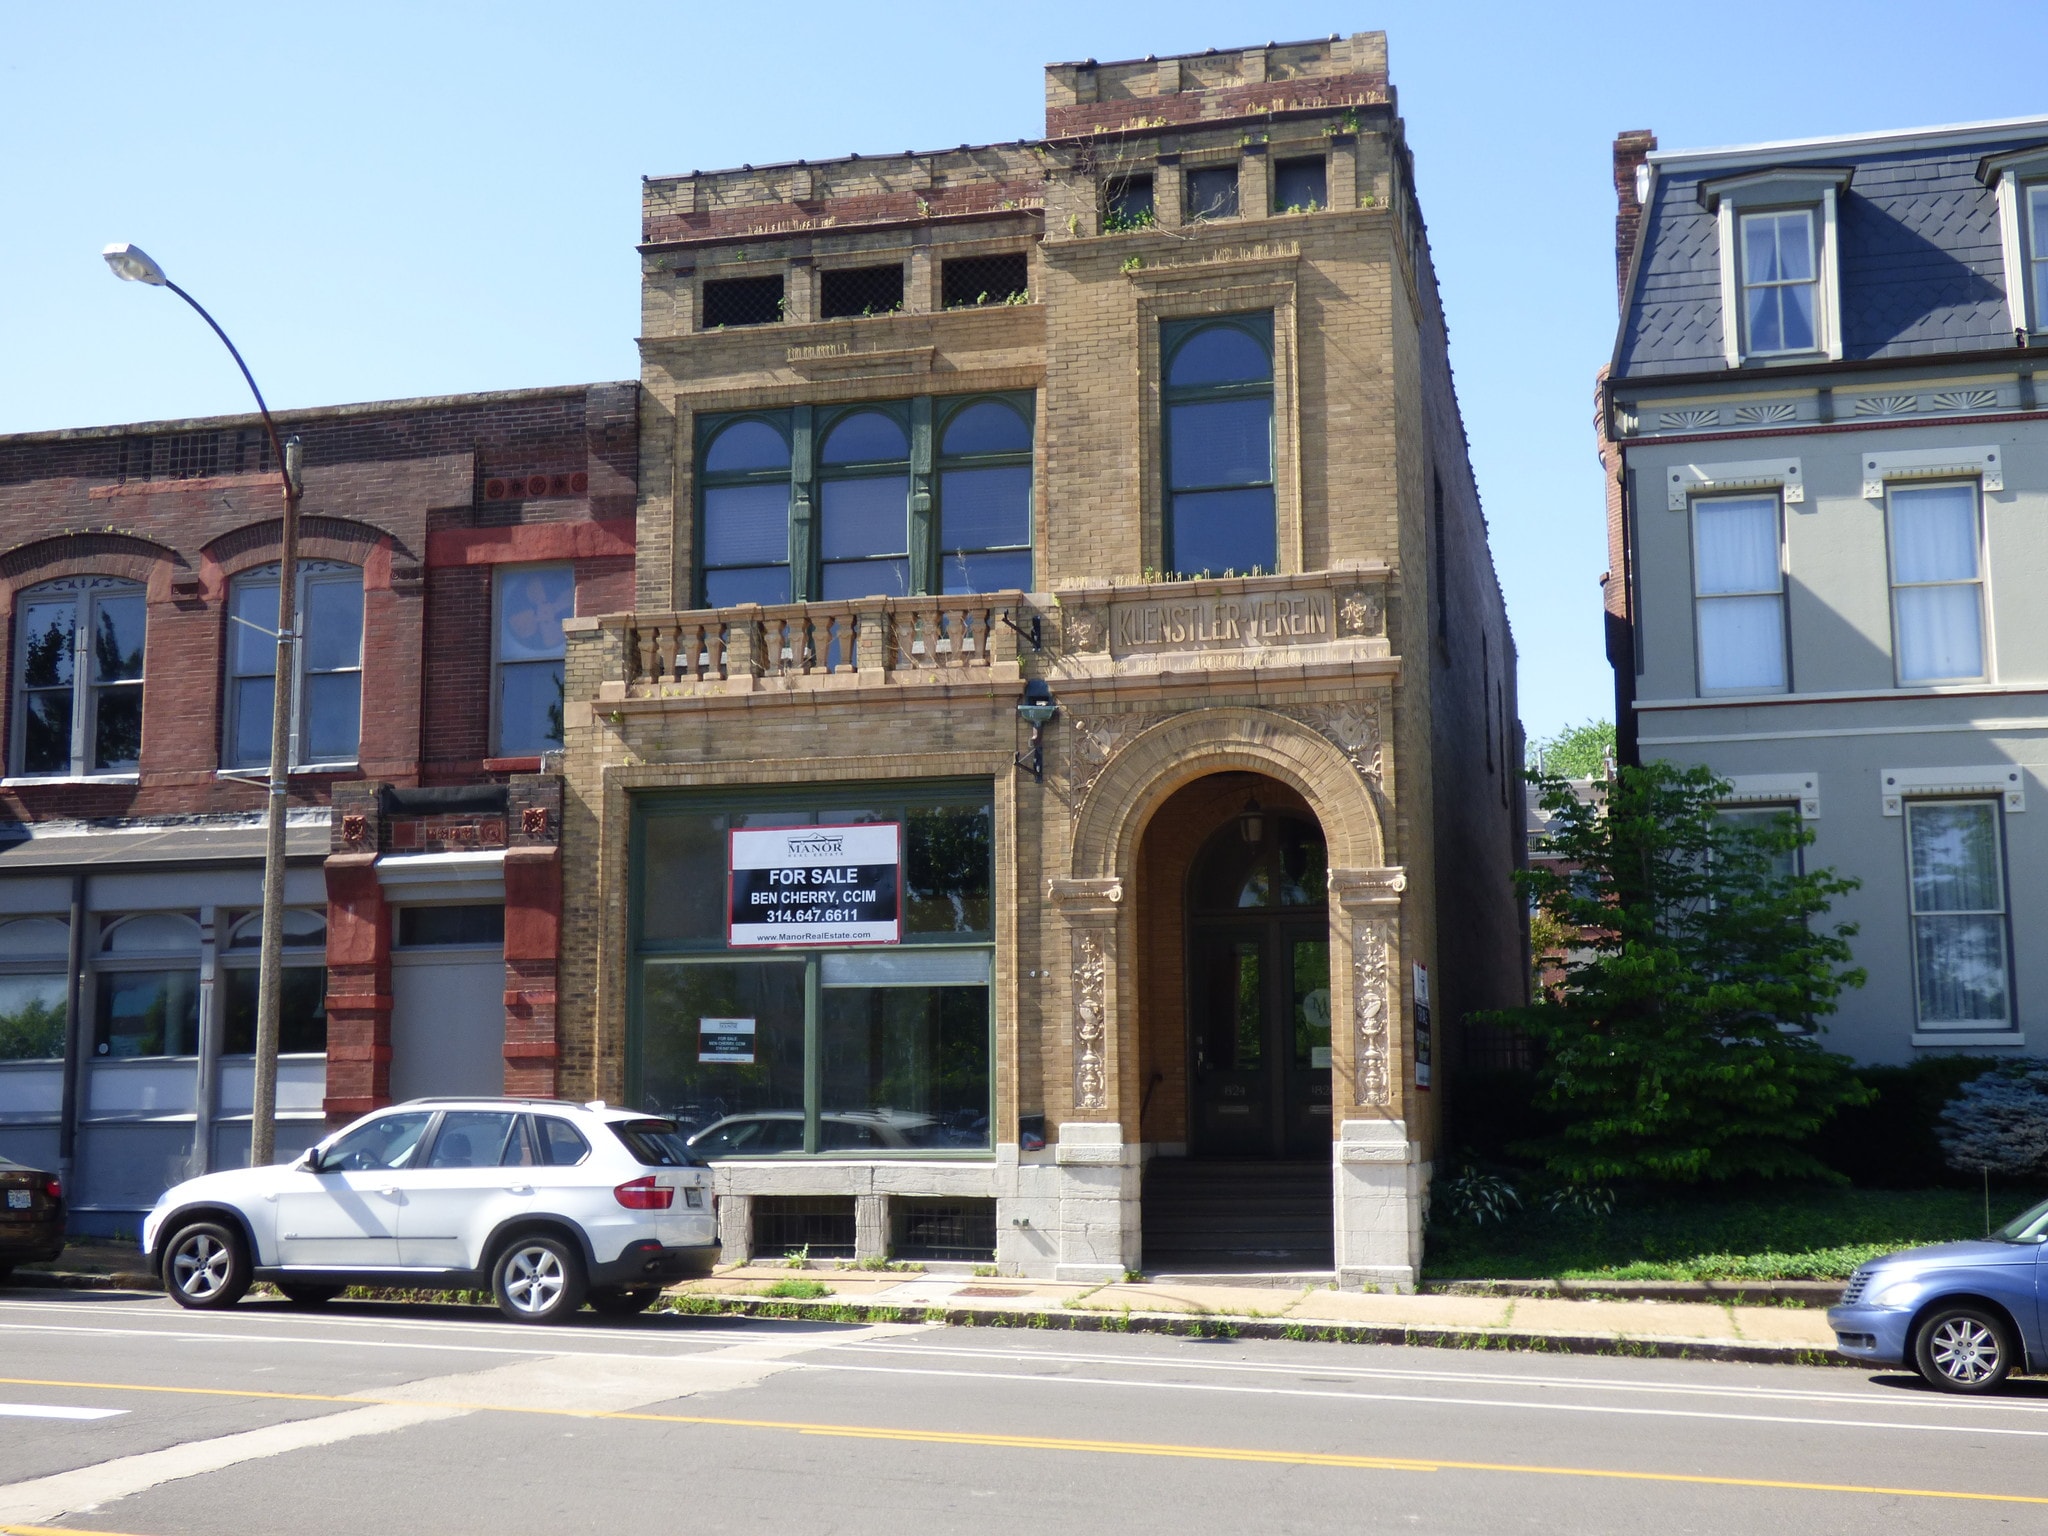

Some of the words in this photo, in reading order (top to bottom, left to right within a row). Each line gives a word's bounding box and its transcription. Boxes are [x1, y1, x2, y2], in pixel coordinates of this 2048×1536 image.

[788, 843, 842, 853] MANOR
[769, 869, 806, 885] FOR
[811, 868, 858, 884] SALE
[751, 892, 777, 905] BEN
[781, 890, 839, 905] CHERRY,
[843, 890, 876, 903] CCIM
[767, 909, 858, 923] 314.647.6611
[757, 931, 871, 942] www.ManorRealEstate.com
